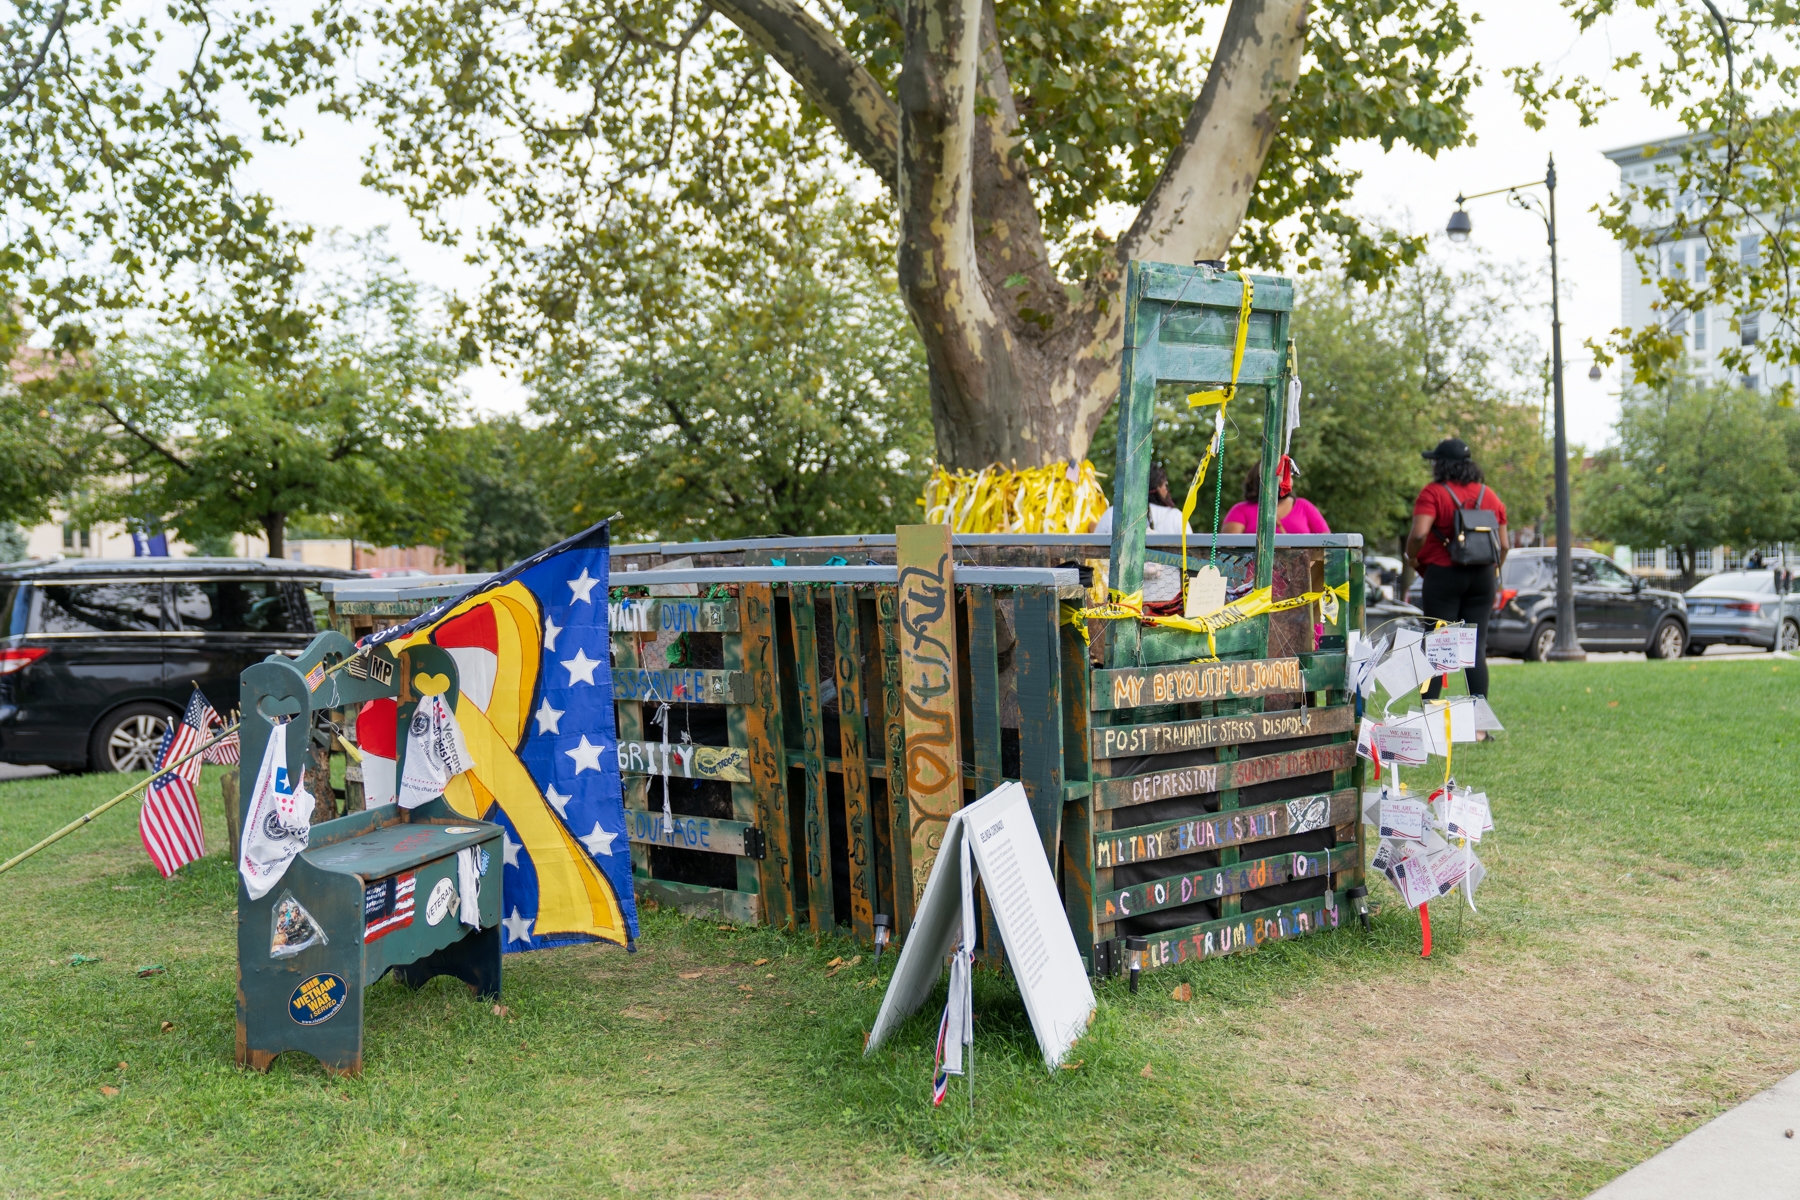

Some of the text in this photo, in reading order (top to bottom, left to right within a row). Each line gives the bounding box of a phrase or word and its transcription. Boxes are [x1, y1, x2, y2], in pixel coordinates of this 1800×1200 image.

[662, 603, 700, 633] DUTY
[373, 657, 392, 683] MP
[1114, 675, 1145, 709] MY
[1154, 664, 1250, 702] BEYOUTIFUL
[442, 722, 463, 774] Veterans
[1105, 713, 1312, 757] POST TRAUMATIC STRESS DISORDER
[1132, 748, 1345, 803] DEPRESSION SUICIDE IDEATION
[1097, 810, 1279, 867] MILITARY SEXUAL ASSAULT
[426, 885, 455, 919] VETERAN
[293, 977, 337, 1009] VIETNAM
[307, 992, 331, 1012] WAR
[313, 999, 337, 1017] SERVED
